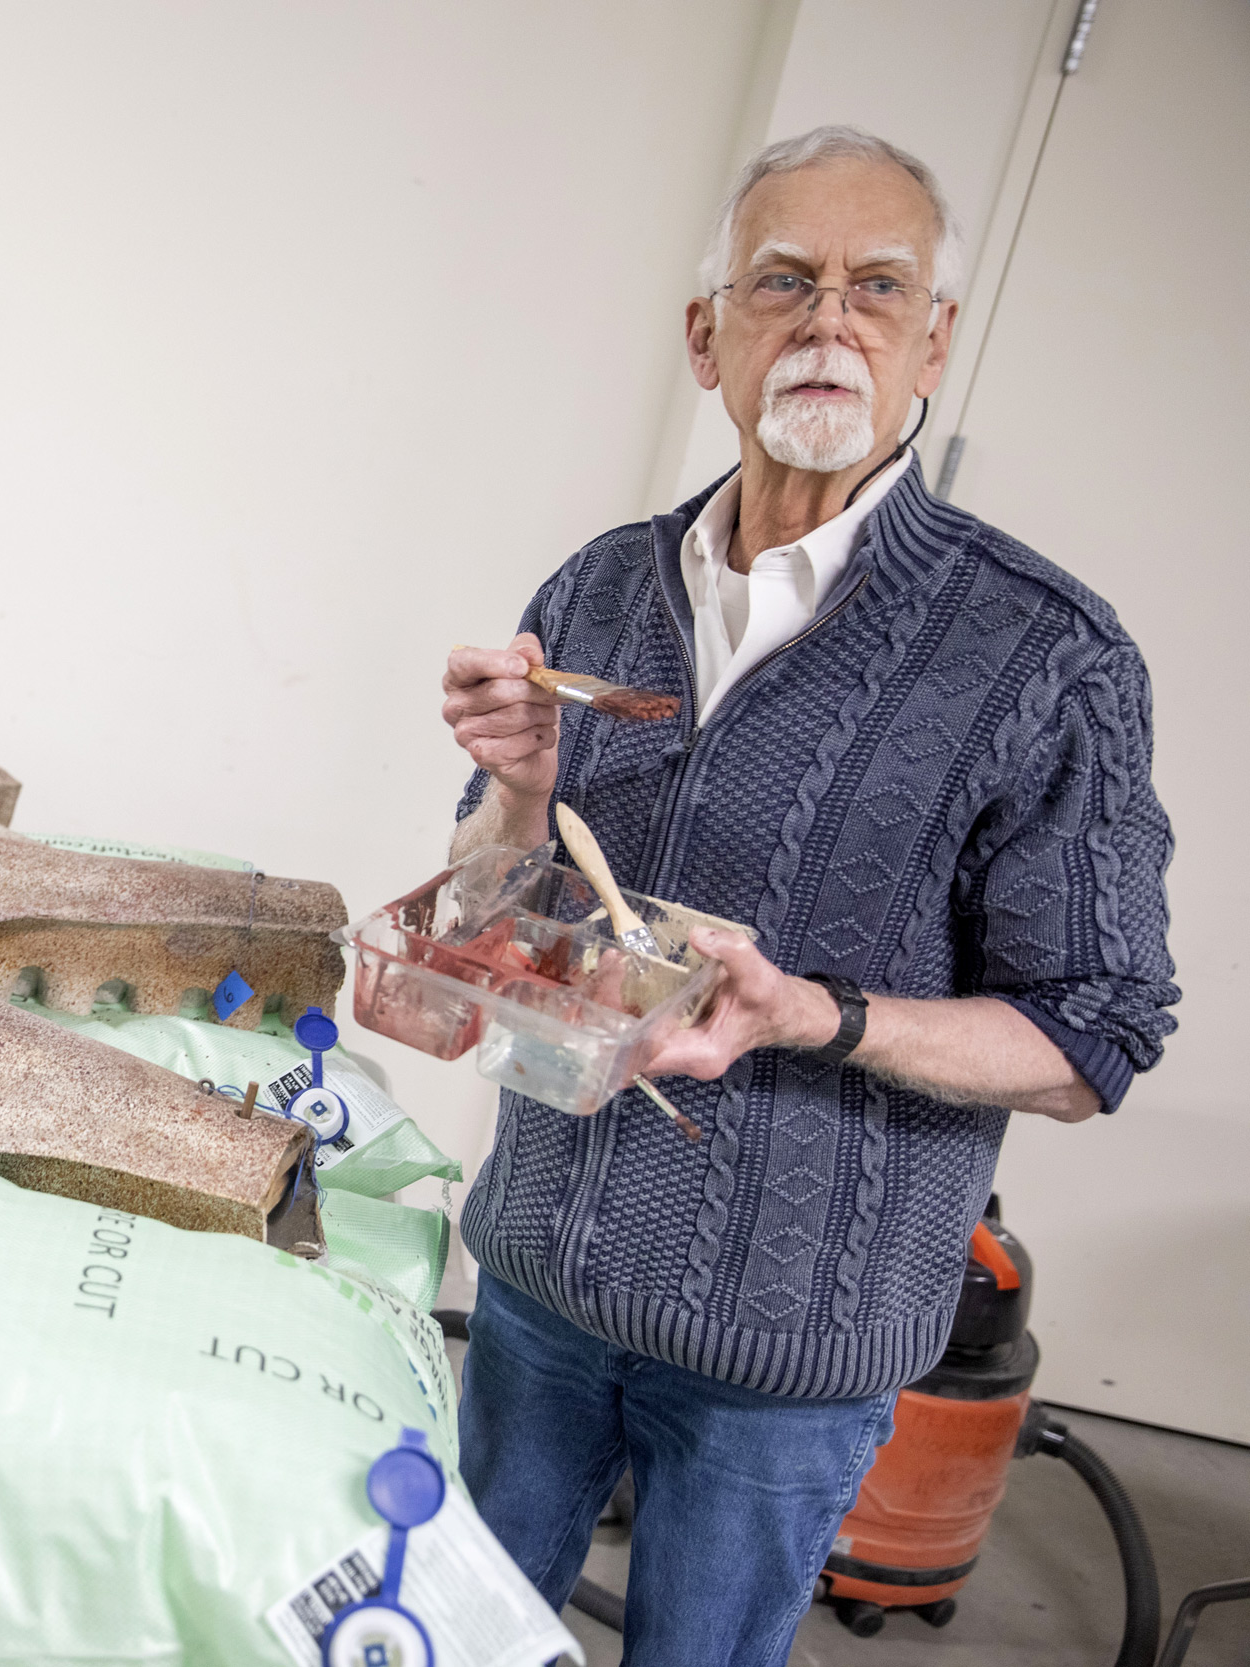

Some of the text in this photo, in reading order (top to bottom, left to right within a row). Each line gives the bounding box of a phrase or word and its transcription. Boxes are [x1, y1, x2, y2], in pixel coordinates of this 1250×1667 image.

[223, 985, 235, 1004] 6
[88, 1228, 132, 1259] OR
[73, 1264, 123, 1319] CUT
[198, 1336, 302, 1382] CUT
[320, 1373, 385, 1422] OR
